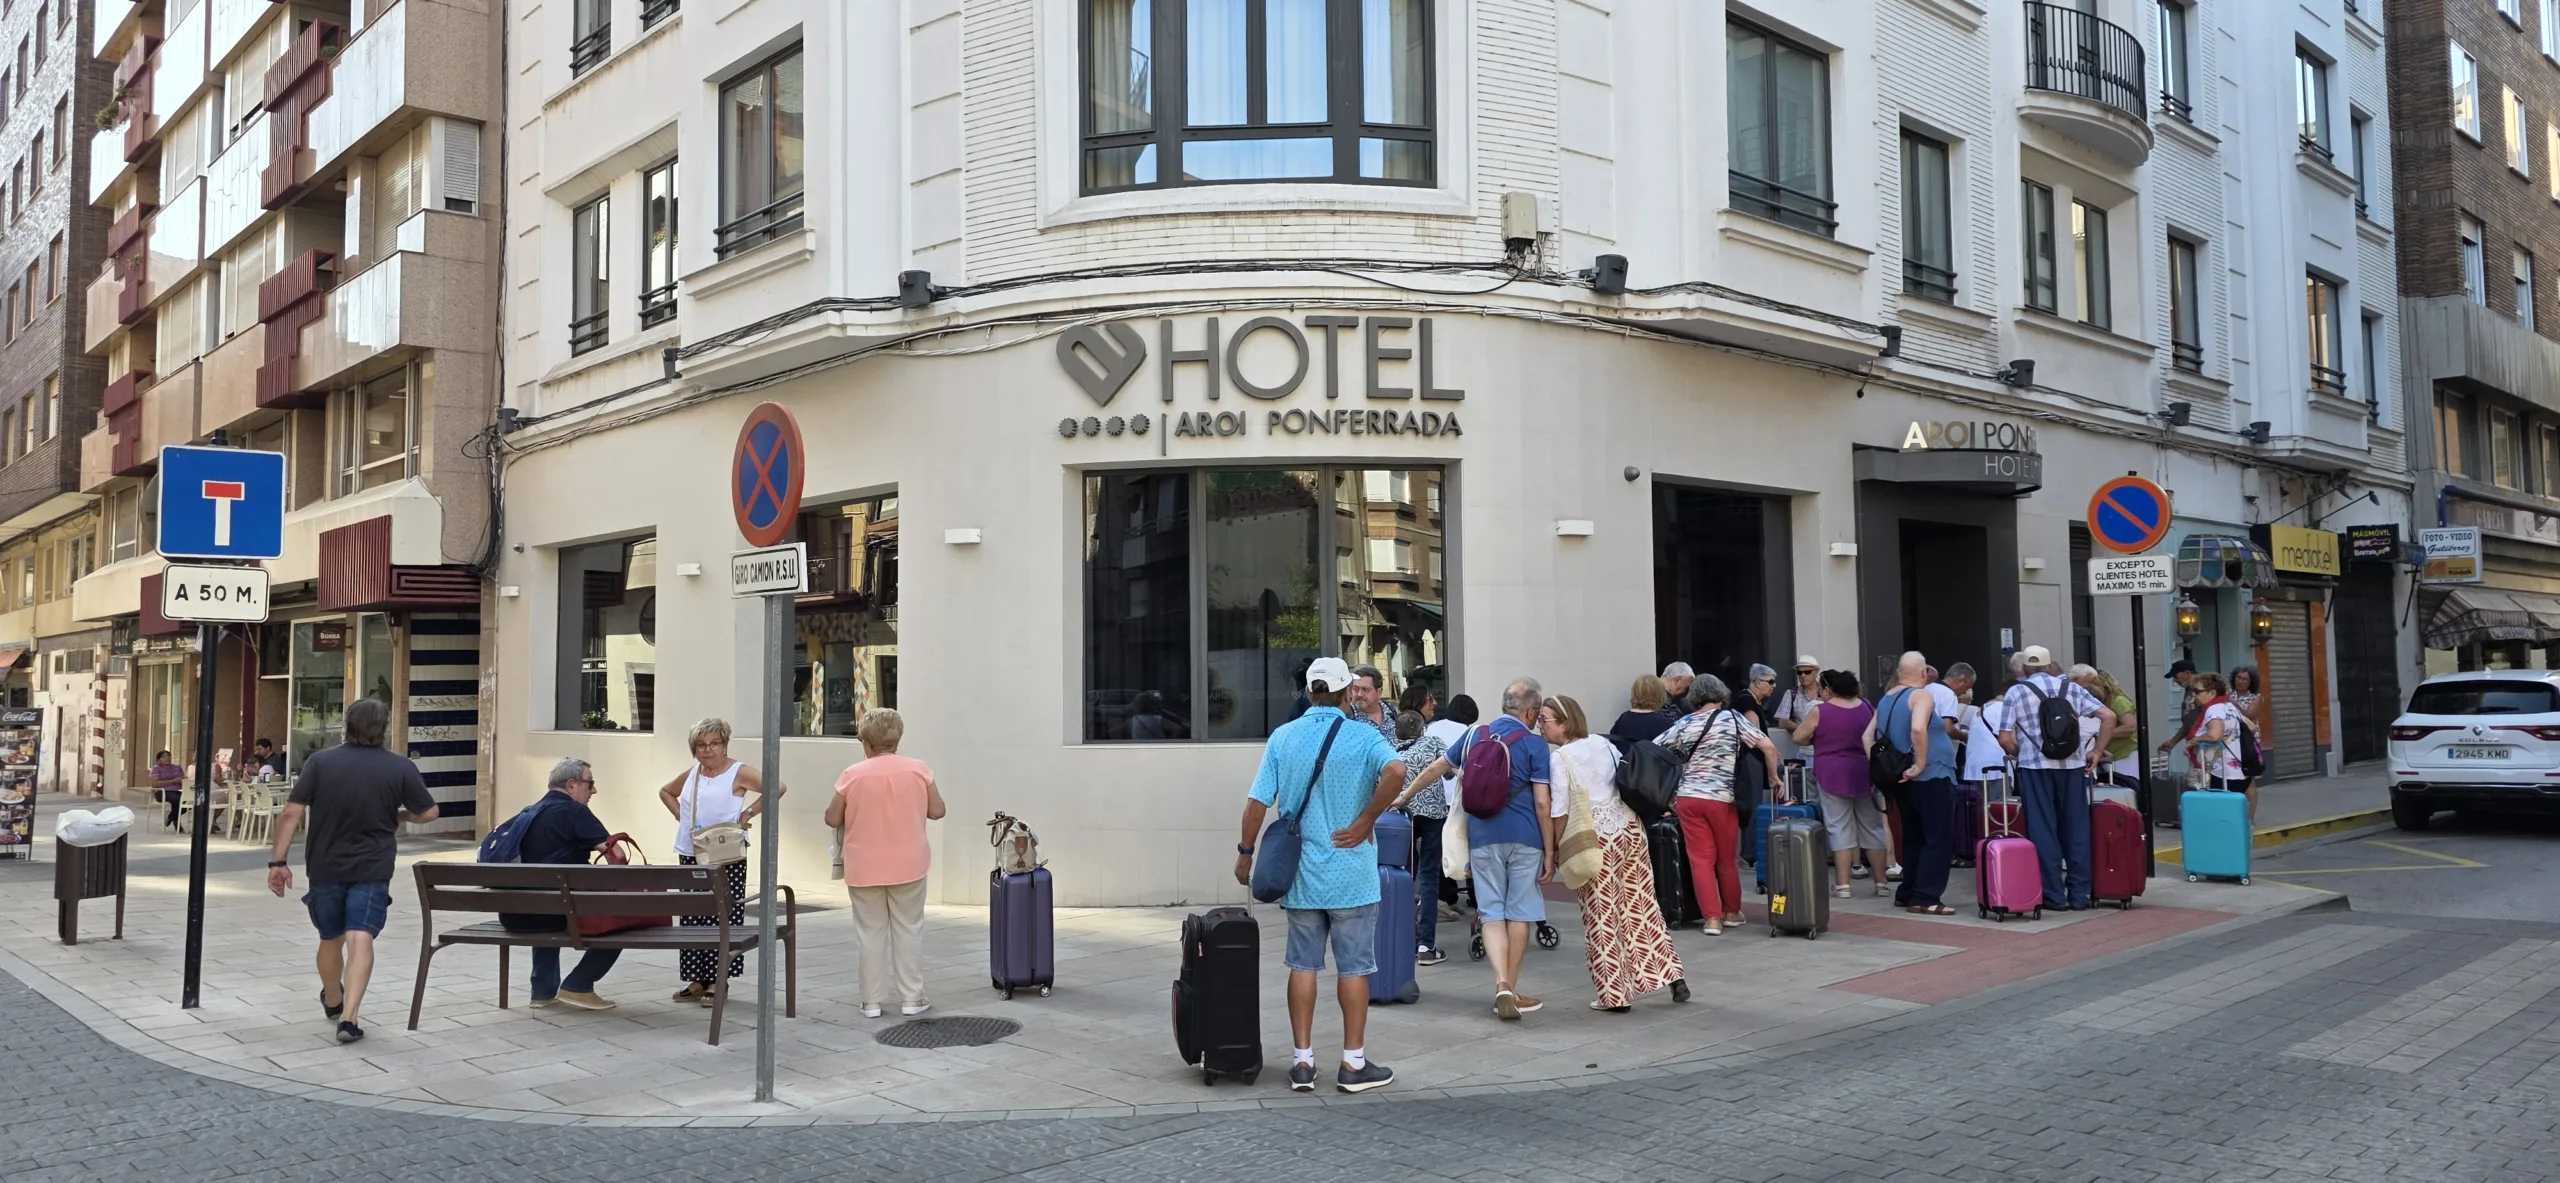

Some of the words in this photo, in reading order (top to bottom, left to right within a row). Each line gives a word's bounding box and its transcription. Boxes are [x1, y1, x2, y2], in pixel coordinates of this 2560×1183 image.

[1160, 315, 1466, 403] HOTEL
[1174, 410, 1246, 438] AROI
[1268, 408, 1464, 438] PONFERRADA
[1902, 420, 1976, 449] AROI
[2425, 533, 2444, 542] FOTO
[2450, 532, 2473, 541] VIDEO
[735, 564, 748, 585] GIRO
[750, 561, 774, 583] CAMION
[776, 559, 796, 580] R.S.U.
[2107, 560, 2155, 569] EXCEPTO
[2095, 571, 2137, 580] CLIENTES
[2139, 570, 2168, 578] HOTEL
[2097, 582, 2135, 590] MAXIMO
[2149, 580, 2167, 588] min.
[175, 584, 189, 601] A
[200, 584, 227, 602] 50
[236, 586, 257, 604] M.
[2455, 749, 2484, 758] 2945
[2487, 749, 2509, 758] KMD
